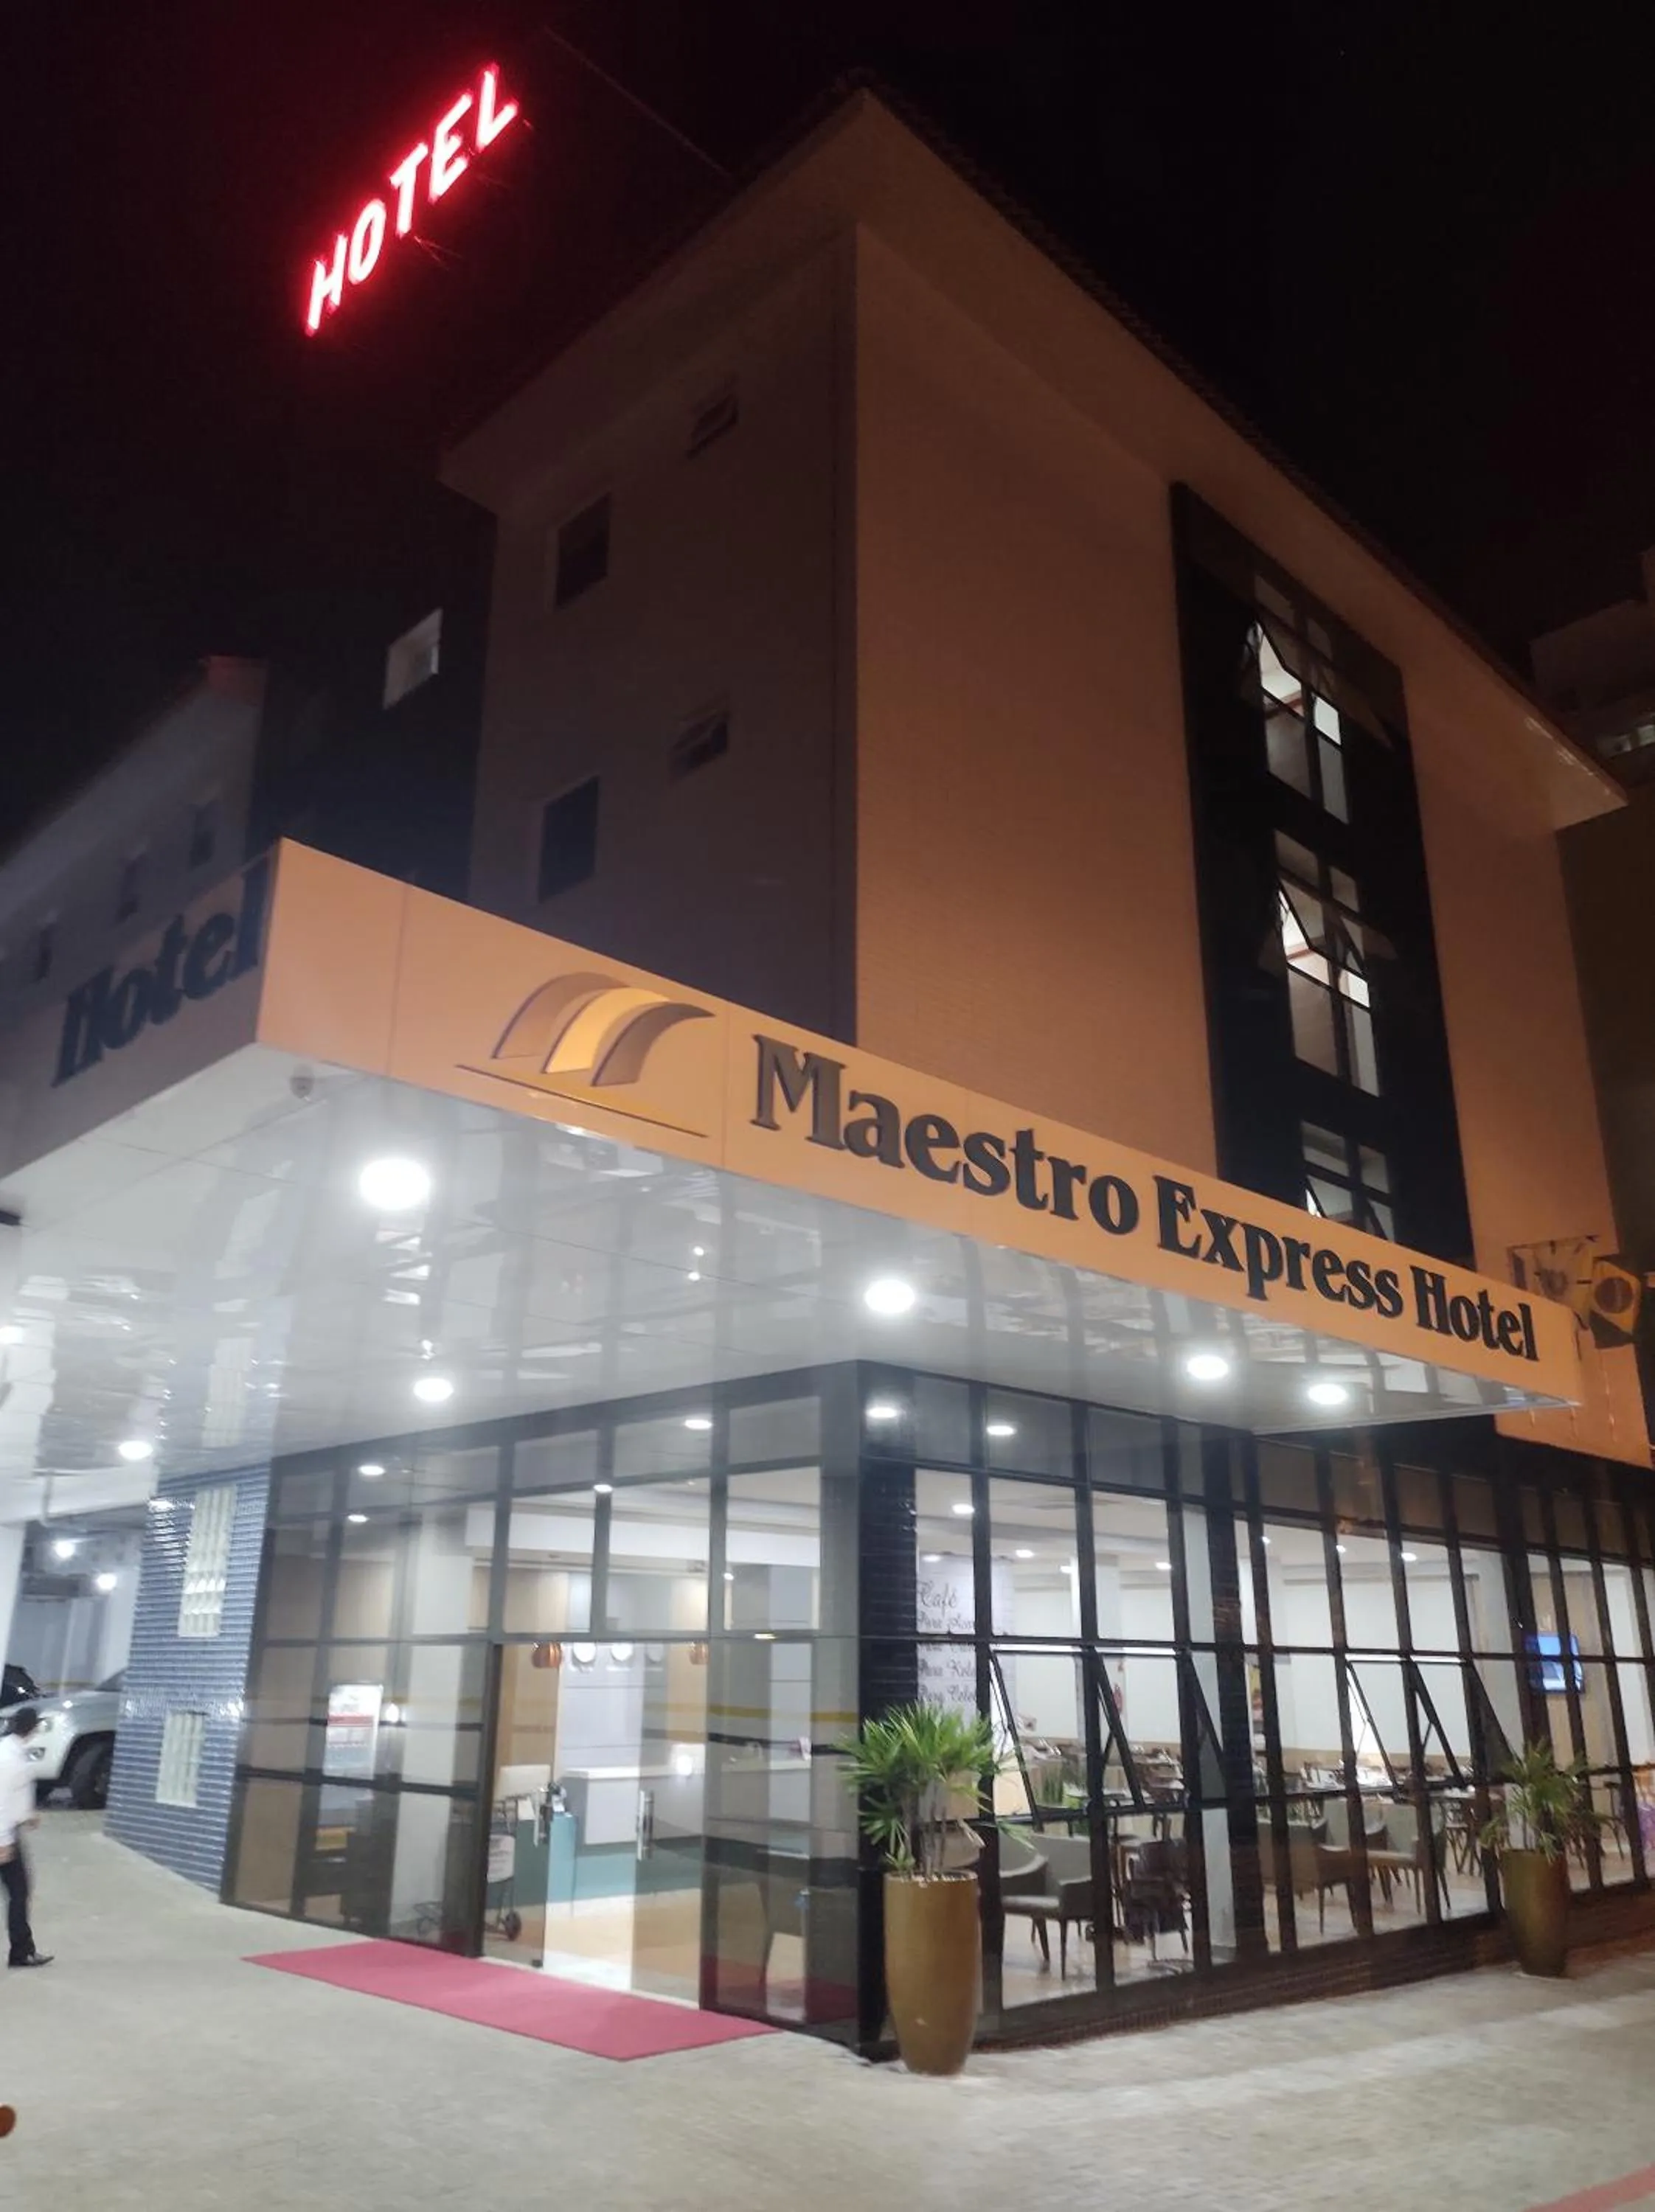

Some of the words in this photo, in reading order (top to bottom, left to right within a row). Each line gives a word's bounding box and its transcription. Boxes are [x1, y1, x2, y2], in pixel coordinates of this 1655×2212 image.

[305, 62, 519, 337] HOTEL
[51, 863, 267, 1088] Hotel
[750, 1034, 1139, 1236] Maestro
[1153, 1175, 1404, 1318] Express
[1409, 1265, 1540, 1362] Hotel
